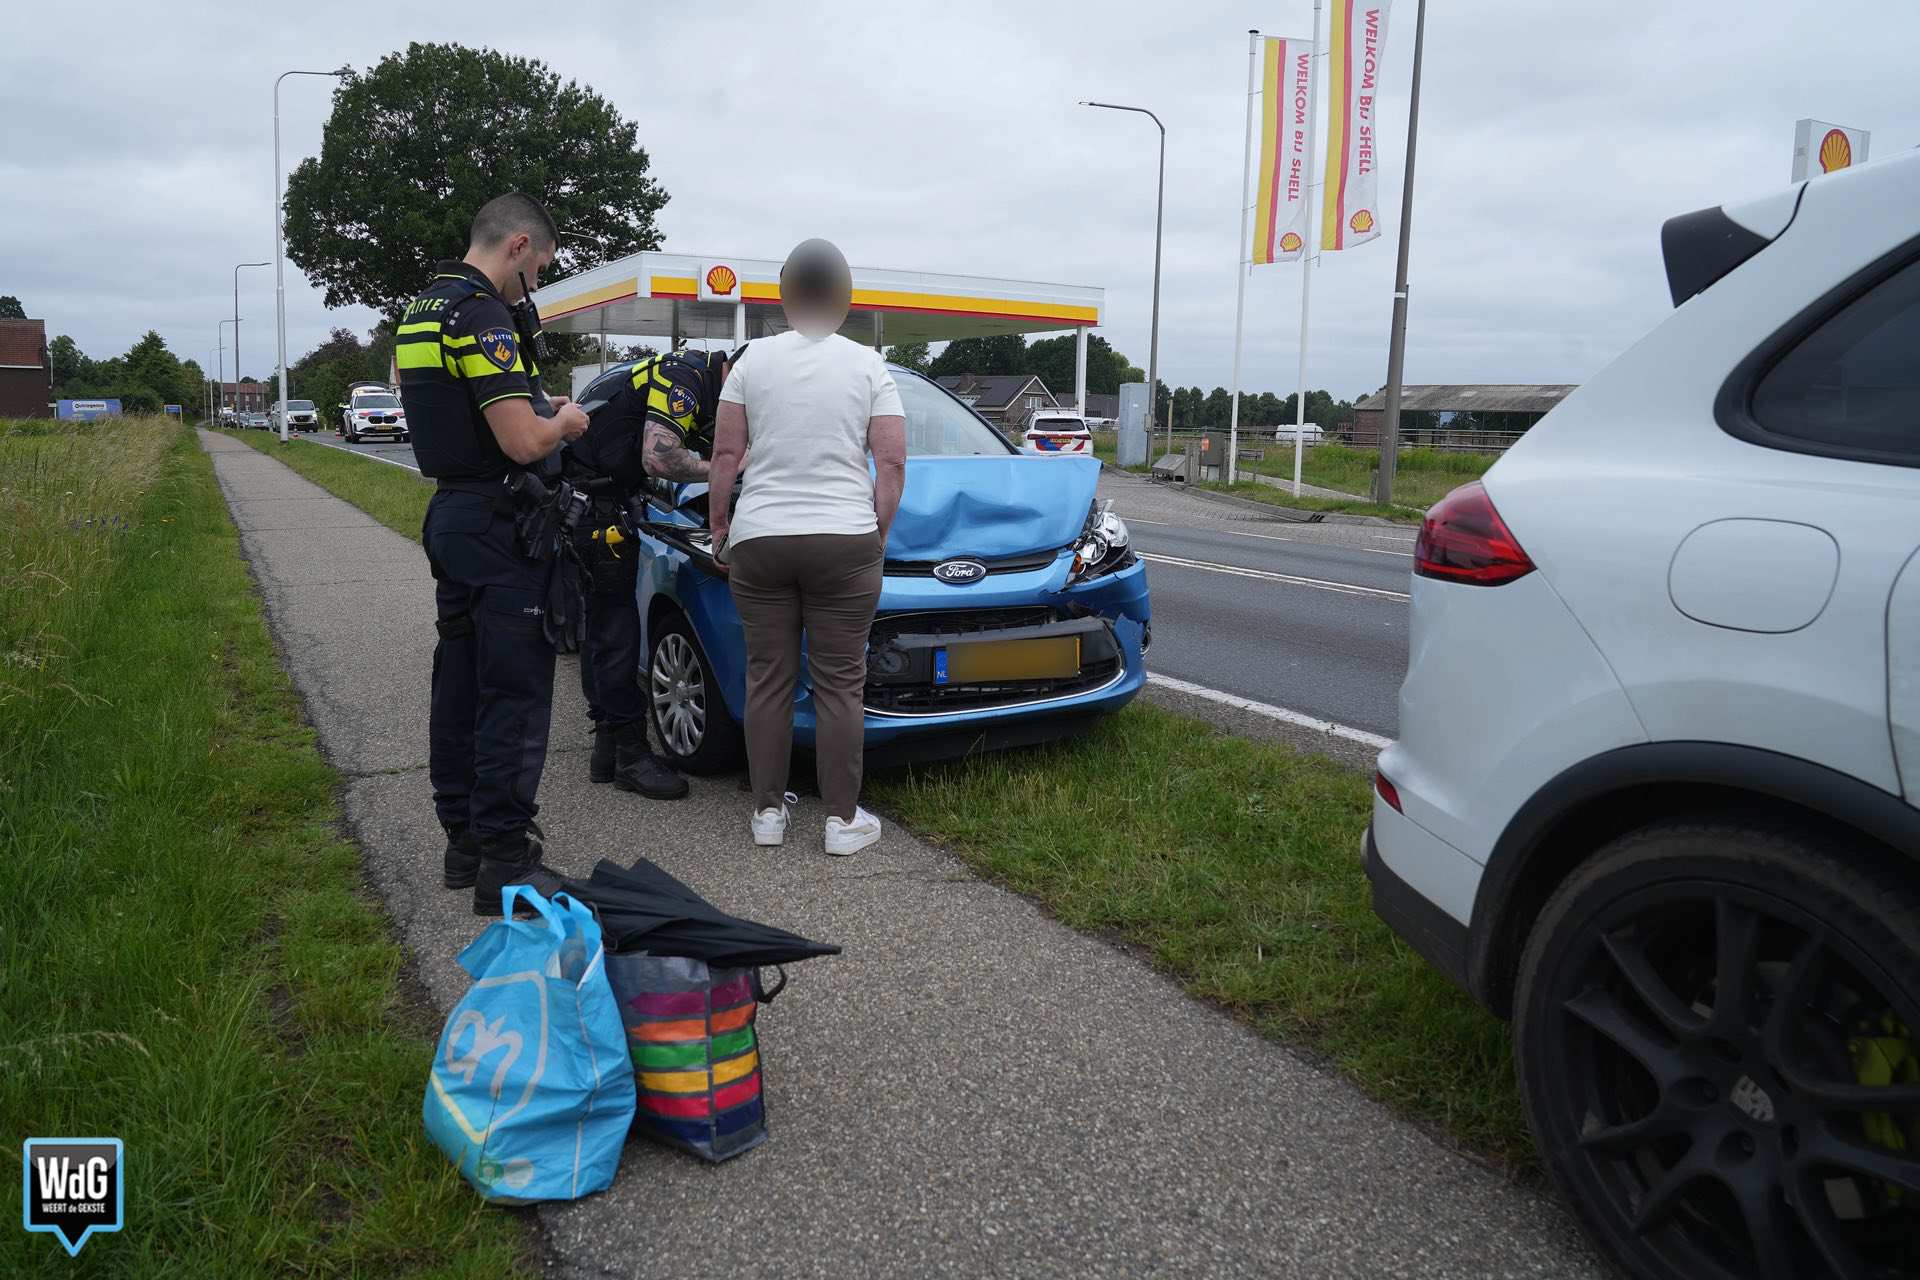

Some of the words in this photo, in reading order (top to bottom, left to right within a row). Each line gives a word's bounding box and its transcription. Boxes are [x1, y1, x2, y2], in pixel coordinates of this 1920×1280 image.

[1362, 8, 1379, 89] WELKOM
[1295, 53, 1309, 124] WELKOM
[1359, 95, 1373, 120] BIJ
[1294, 130, 1304, 153] BIJ
[1359, 125, 1372, 176] SHELL
[1288, 157, 1302, 202] SHELL
[403, 298, 444, 322] OLITIE
[482, 332, 512, 343] POLITIE
[945, 564, 975, 577] Ford
